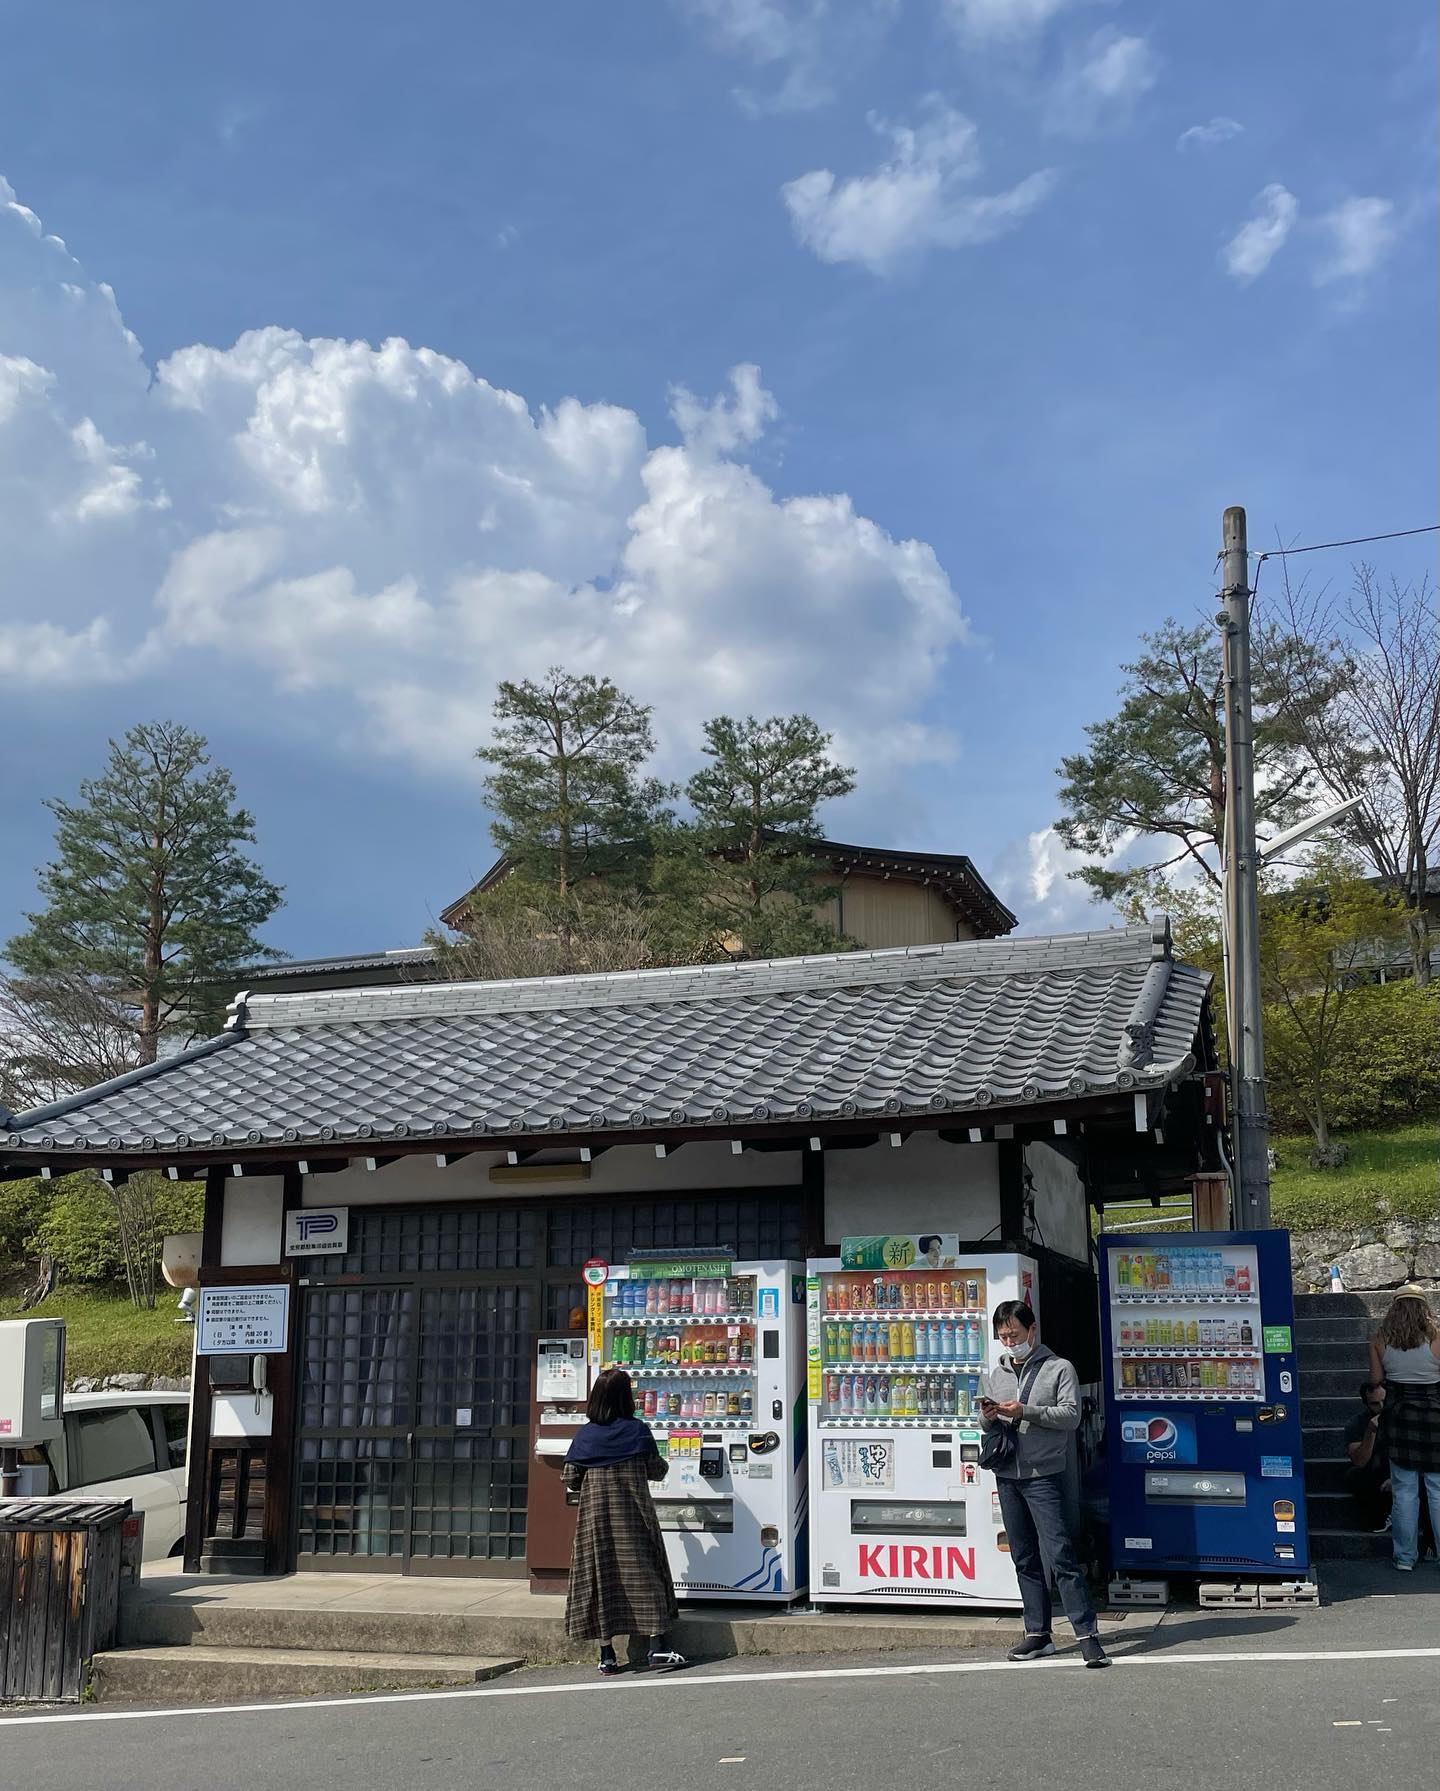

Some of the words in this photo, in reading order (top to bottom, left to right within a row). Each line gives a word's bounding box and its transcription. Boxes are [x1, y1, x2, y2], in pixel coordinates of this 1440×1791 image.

[671, 1263, 728, 1273] OMOTENASHI
[889, 1241, 911, 1265] 新
[869, 1444, 887, 1480] ゆず
[859, 1544, 976, 1580] KIRIN
